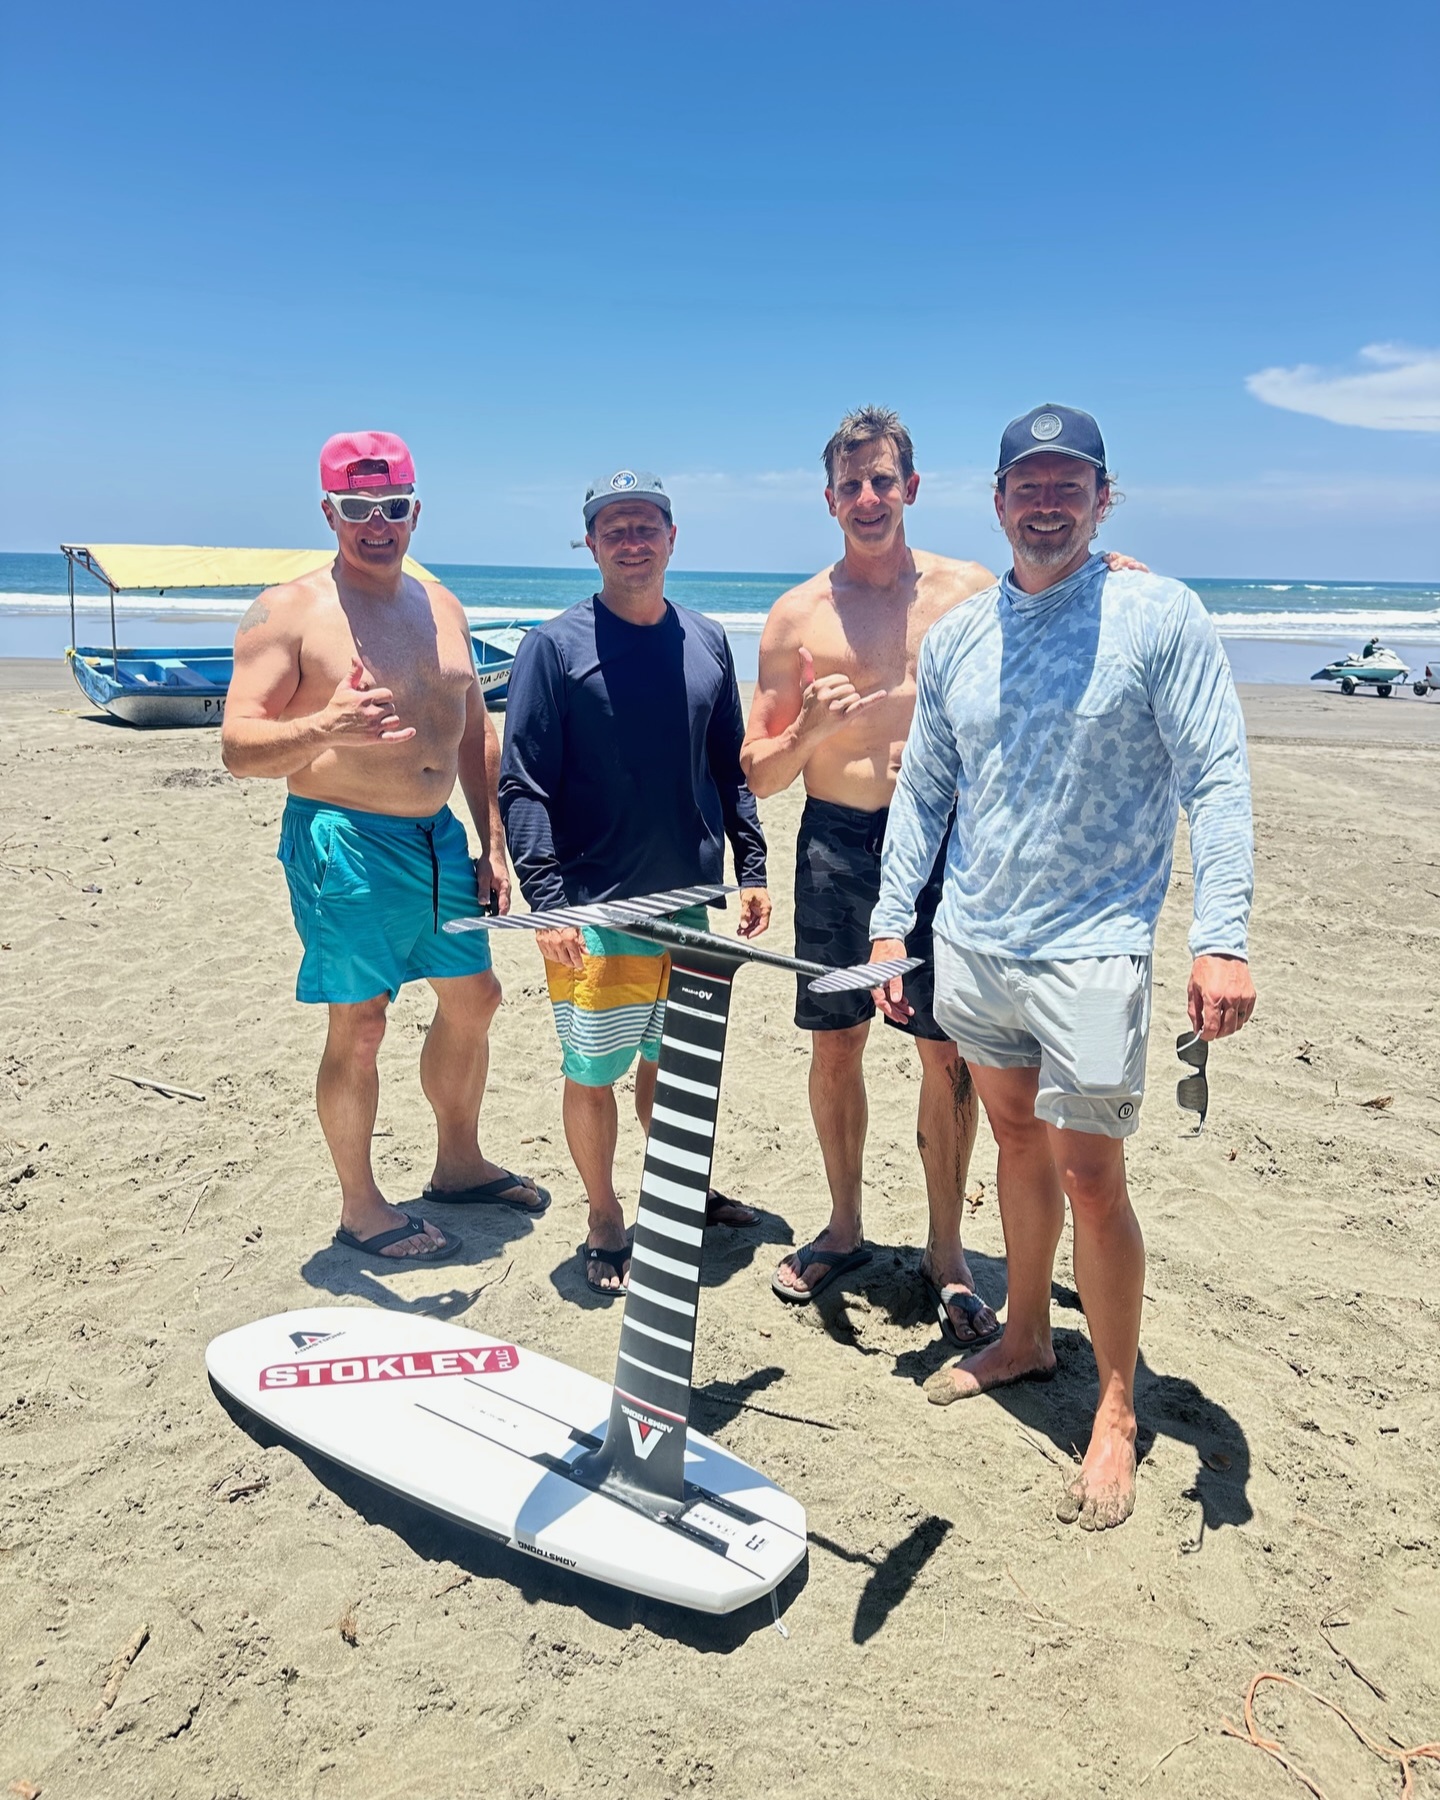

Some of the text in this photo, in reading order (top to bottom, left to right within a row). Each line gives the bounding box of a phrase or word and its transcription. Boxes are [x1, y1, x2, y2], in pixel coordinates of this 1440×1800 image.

[204, 699, 212, 712] P
[265, 1349, 513, 1387] STOKLEY PLLC
[621, 1404, 674, 1434] ARMSTRONG
[517, 1540, 577, 1568] ARMSTRONG
